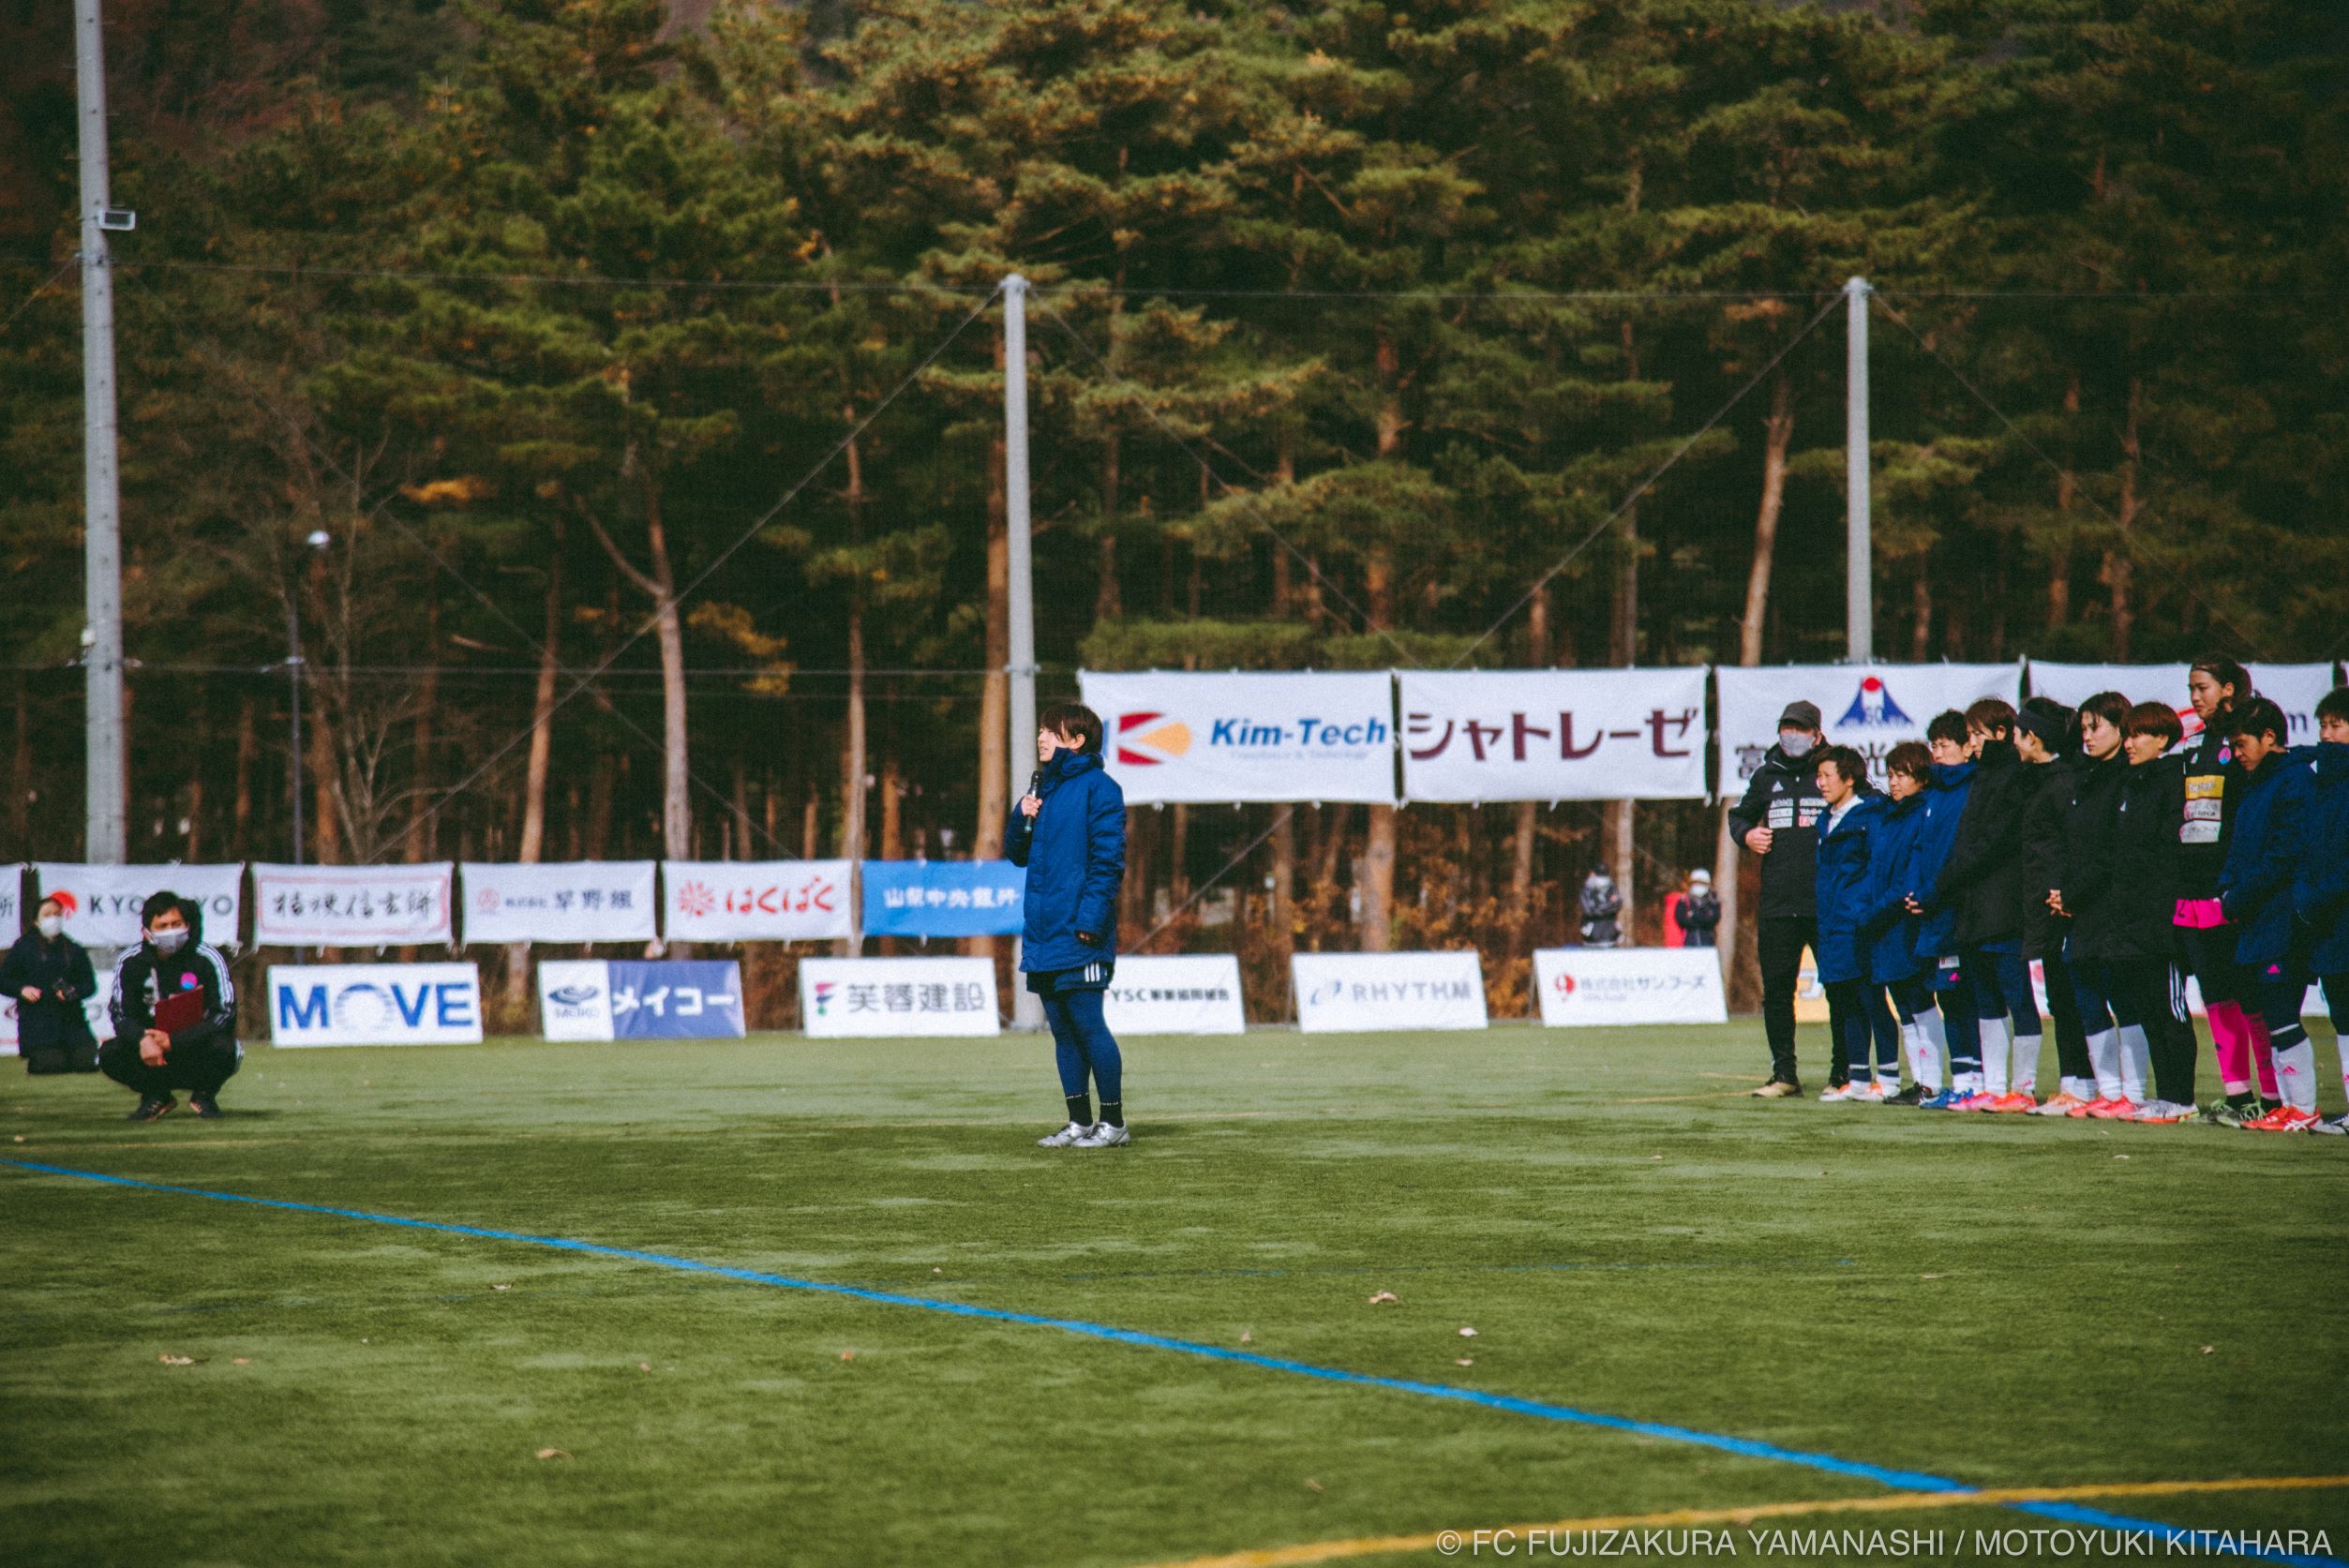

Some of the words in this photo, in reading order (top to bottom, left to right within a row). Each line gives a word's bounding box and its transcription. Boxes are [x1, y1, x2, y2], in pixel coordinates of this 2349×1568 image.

[1210, 717, 1386, 746] Kim-Tech
[1408, 709, 1698, 761] シャトレーゼ
[726, 875, 834, 915] はくばく
[278, 982, 473, 1029] MOVE
[612, 986, 736, 1017] メイコー
[847, 982, 985, 1012] 芙蓉建設
[1352, 982, 1471, 1001] RHYTHM
